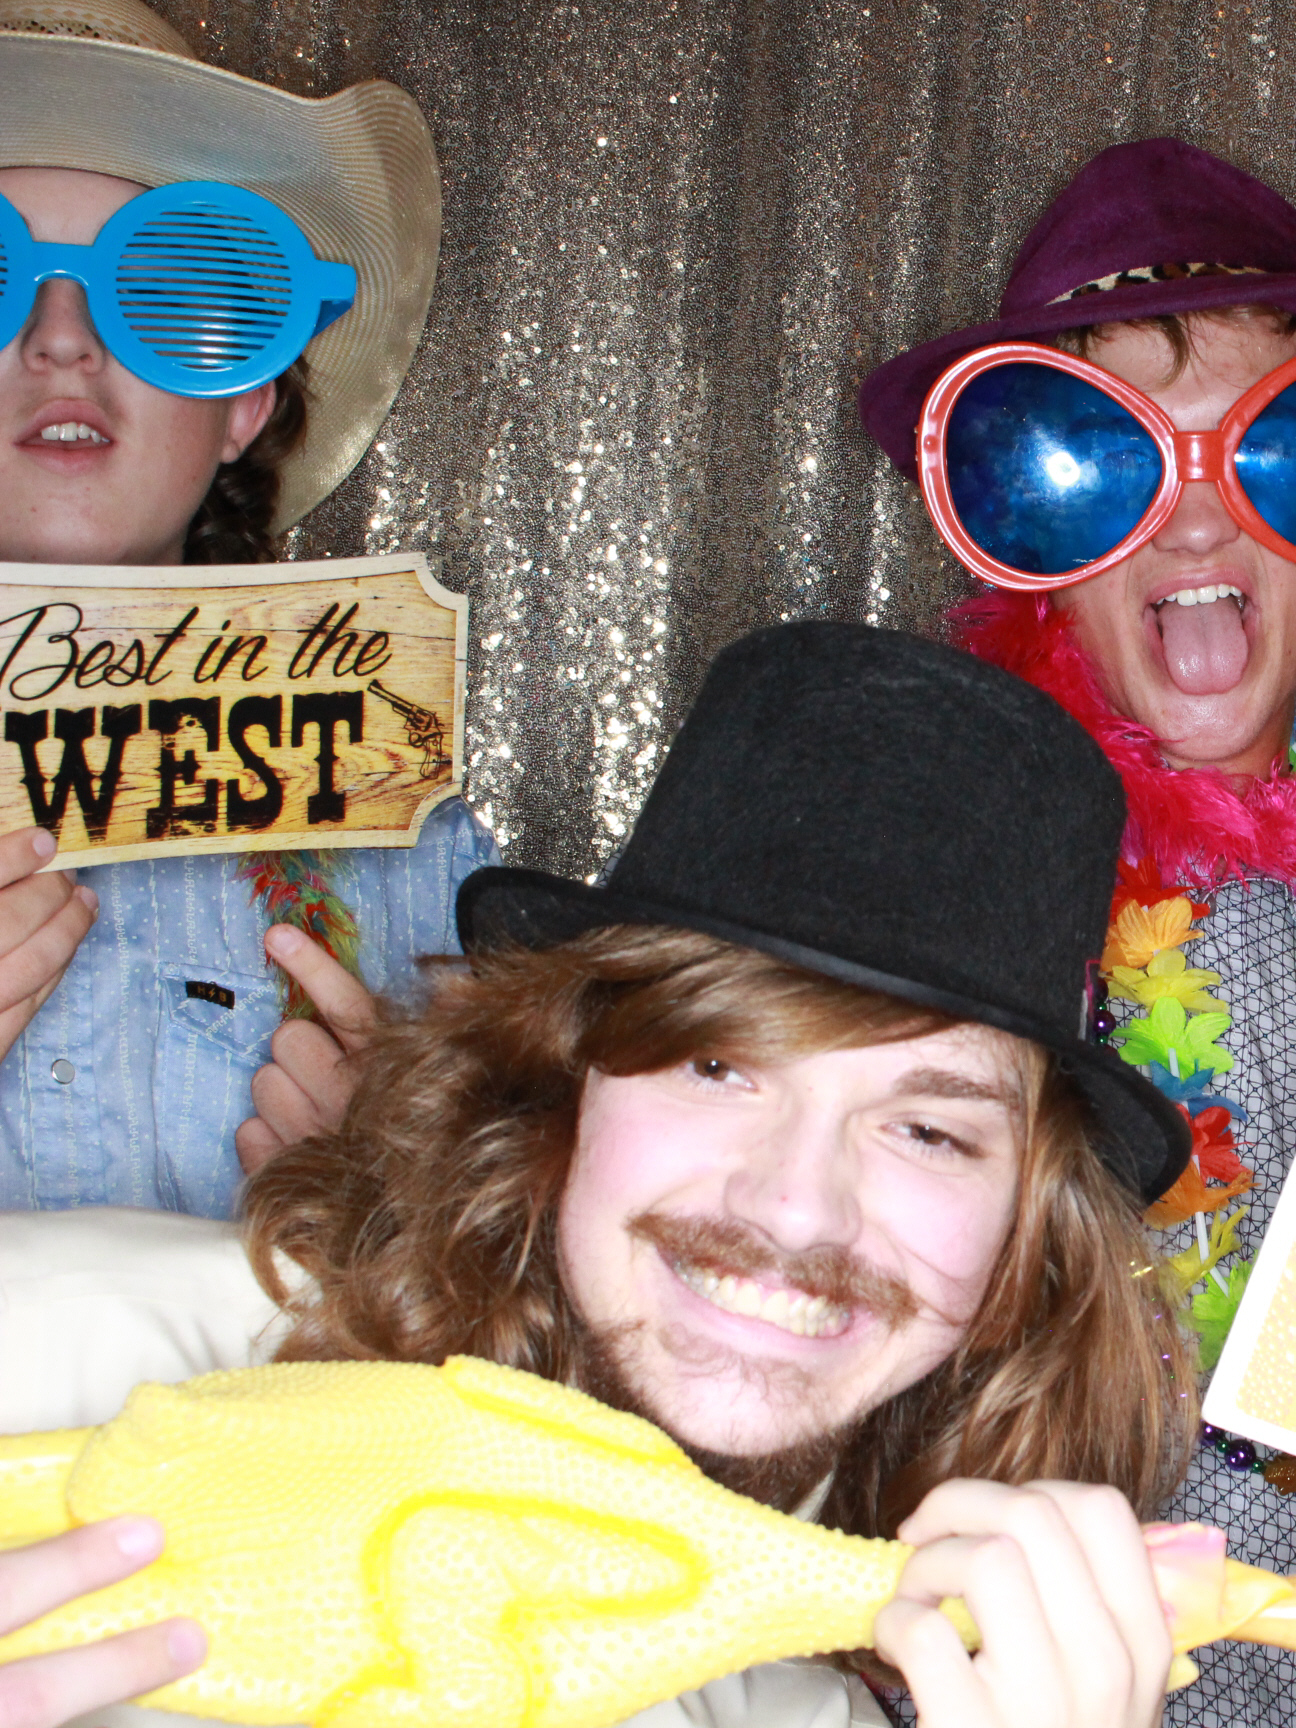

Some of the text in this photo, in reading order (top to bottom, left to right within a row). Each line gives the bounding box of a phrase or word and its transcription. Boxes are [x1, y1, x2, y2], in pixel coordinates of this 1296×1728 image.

[0, 601, 392, 701] Best in the
[4, 690, 364, 843] WEST
